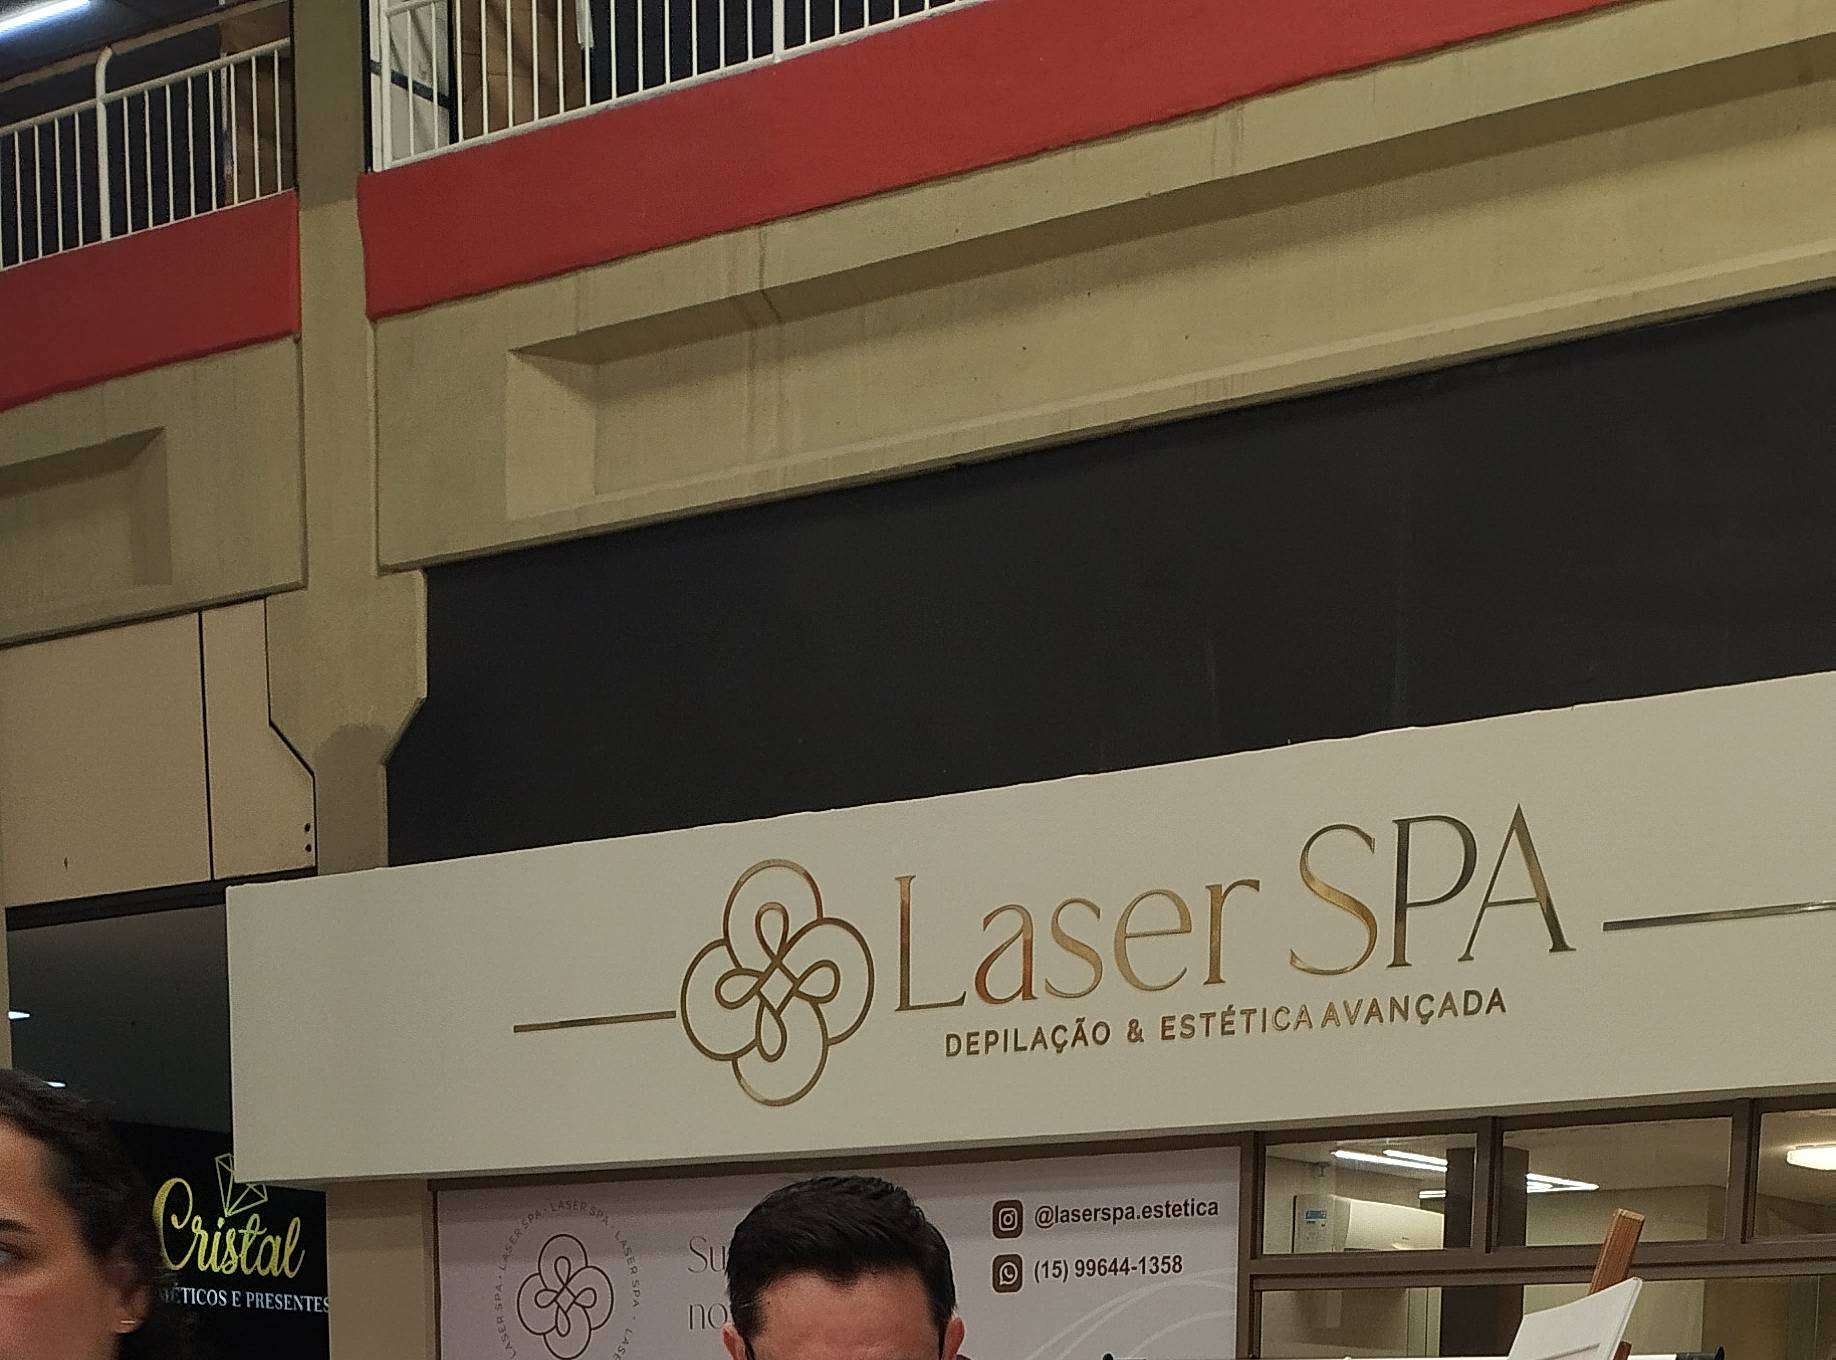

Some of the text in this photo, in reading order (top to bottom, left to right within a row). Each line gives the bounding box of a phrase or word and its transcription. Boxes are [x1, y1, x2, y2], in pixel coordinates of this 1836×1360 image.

[894, 803, 1577, 1012] Laser SPA
[945, 987, 1507, 1057] DEPILAÇÃO & ESTÉTICA AVANÇADA
[153, 1177, 305, 1278] Cristal
[499, 1209, 541, 1271] LASER SPA
[550, 1200, 609, 1226] LASER SPA
[1035, 1198, 1218, 1229] @laserspa.estetica
[231, 1290, 242, 1307] E
[246, 1291, 330, 1313] PRESENTES
[614, 1230, 641, 1307] LASER SPA
[1034, 1255, 1183, 1284] (15) 99644-1358
[494, 1284, 517, 1359] LASER SPA
